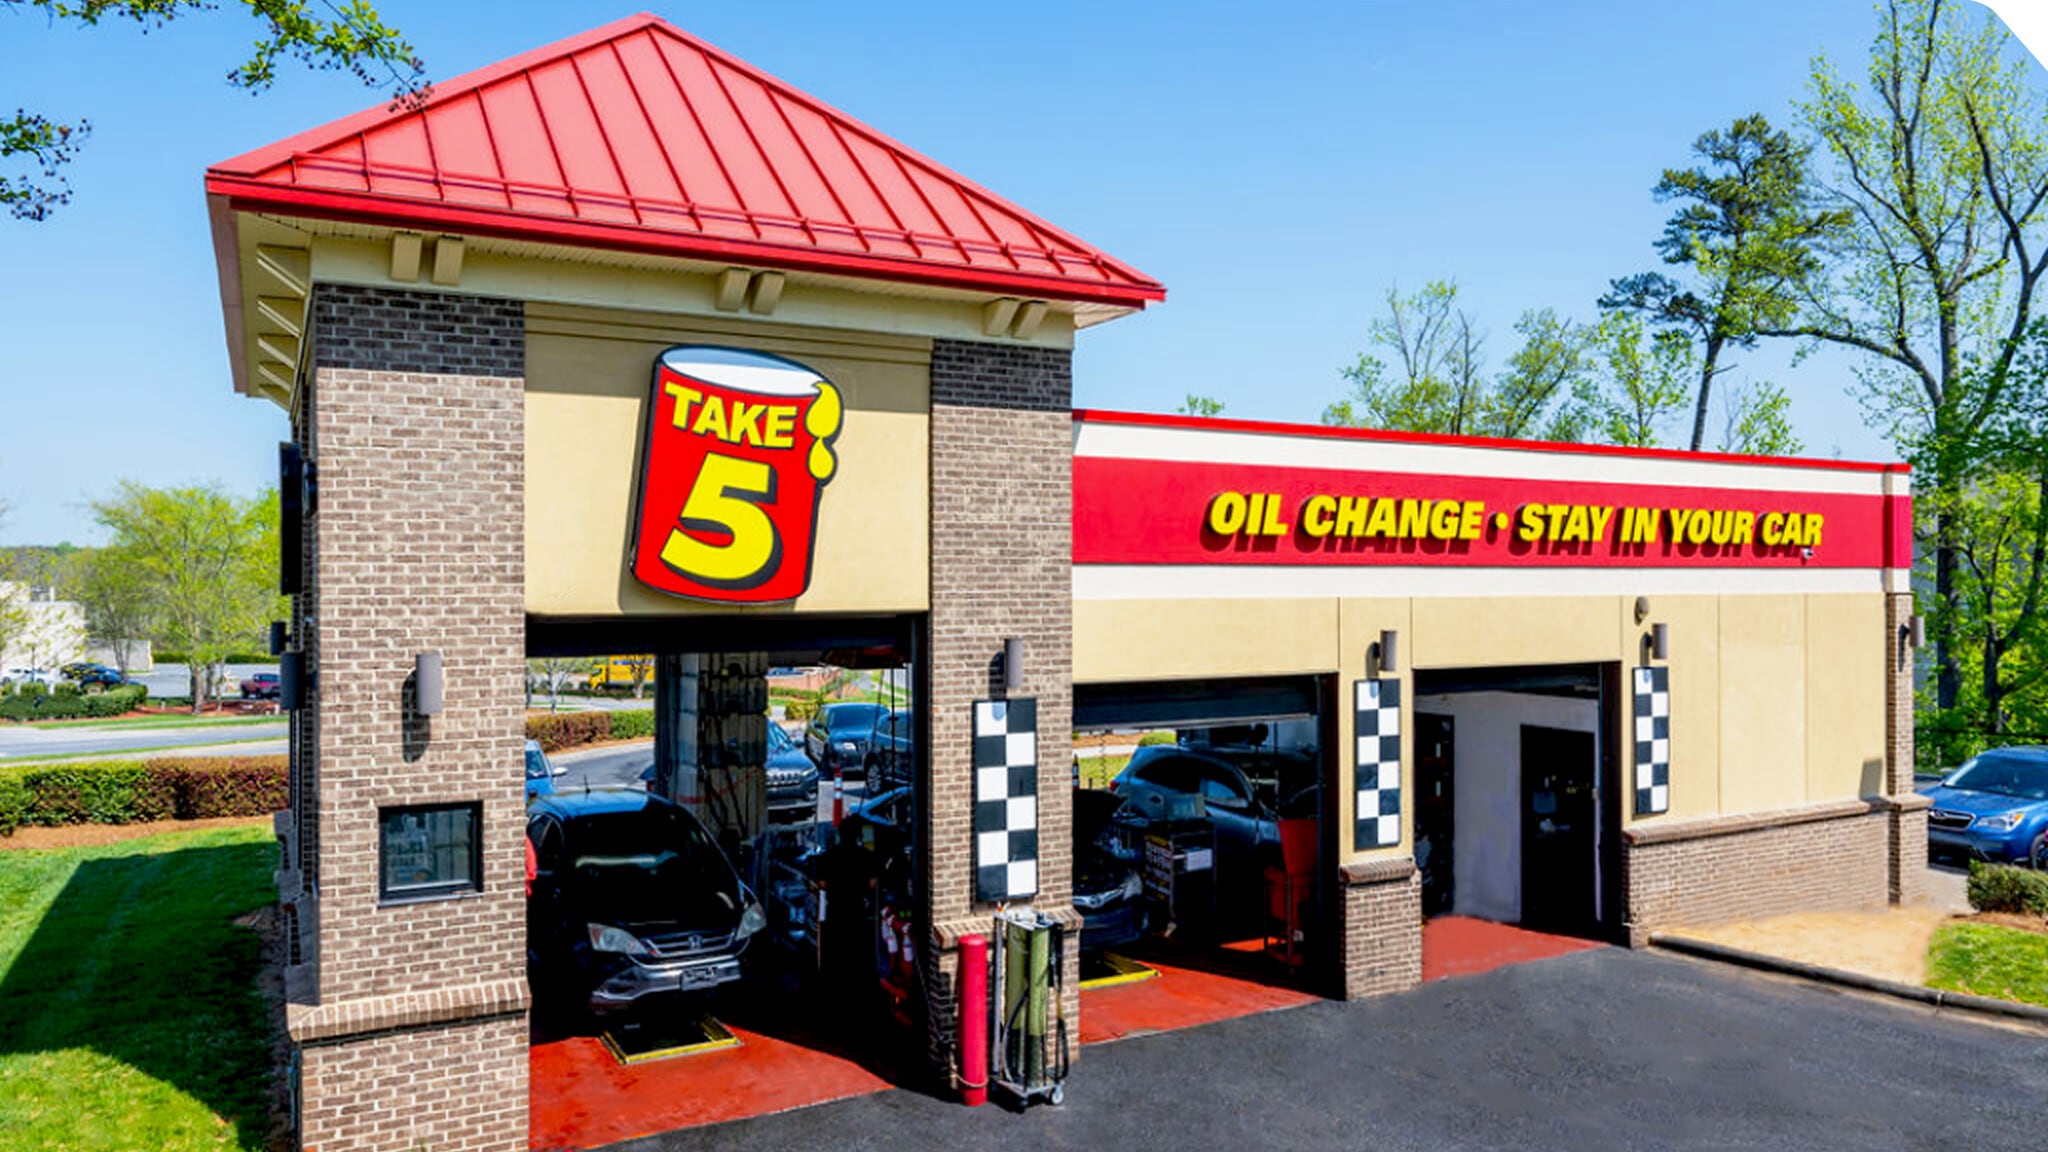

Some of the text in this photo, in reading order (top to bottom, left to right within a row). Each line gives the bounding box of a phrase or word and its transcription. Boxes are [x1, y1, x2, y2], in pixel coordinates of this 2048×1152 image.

[665, 381, 798, 448] TAKE
[659, 452, 777, 582] 5
[1209, 492, 1824, 547] OIL CHANGE STAY IN YOUR CAR
